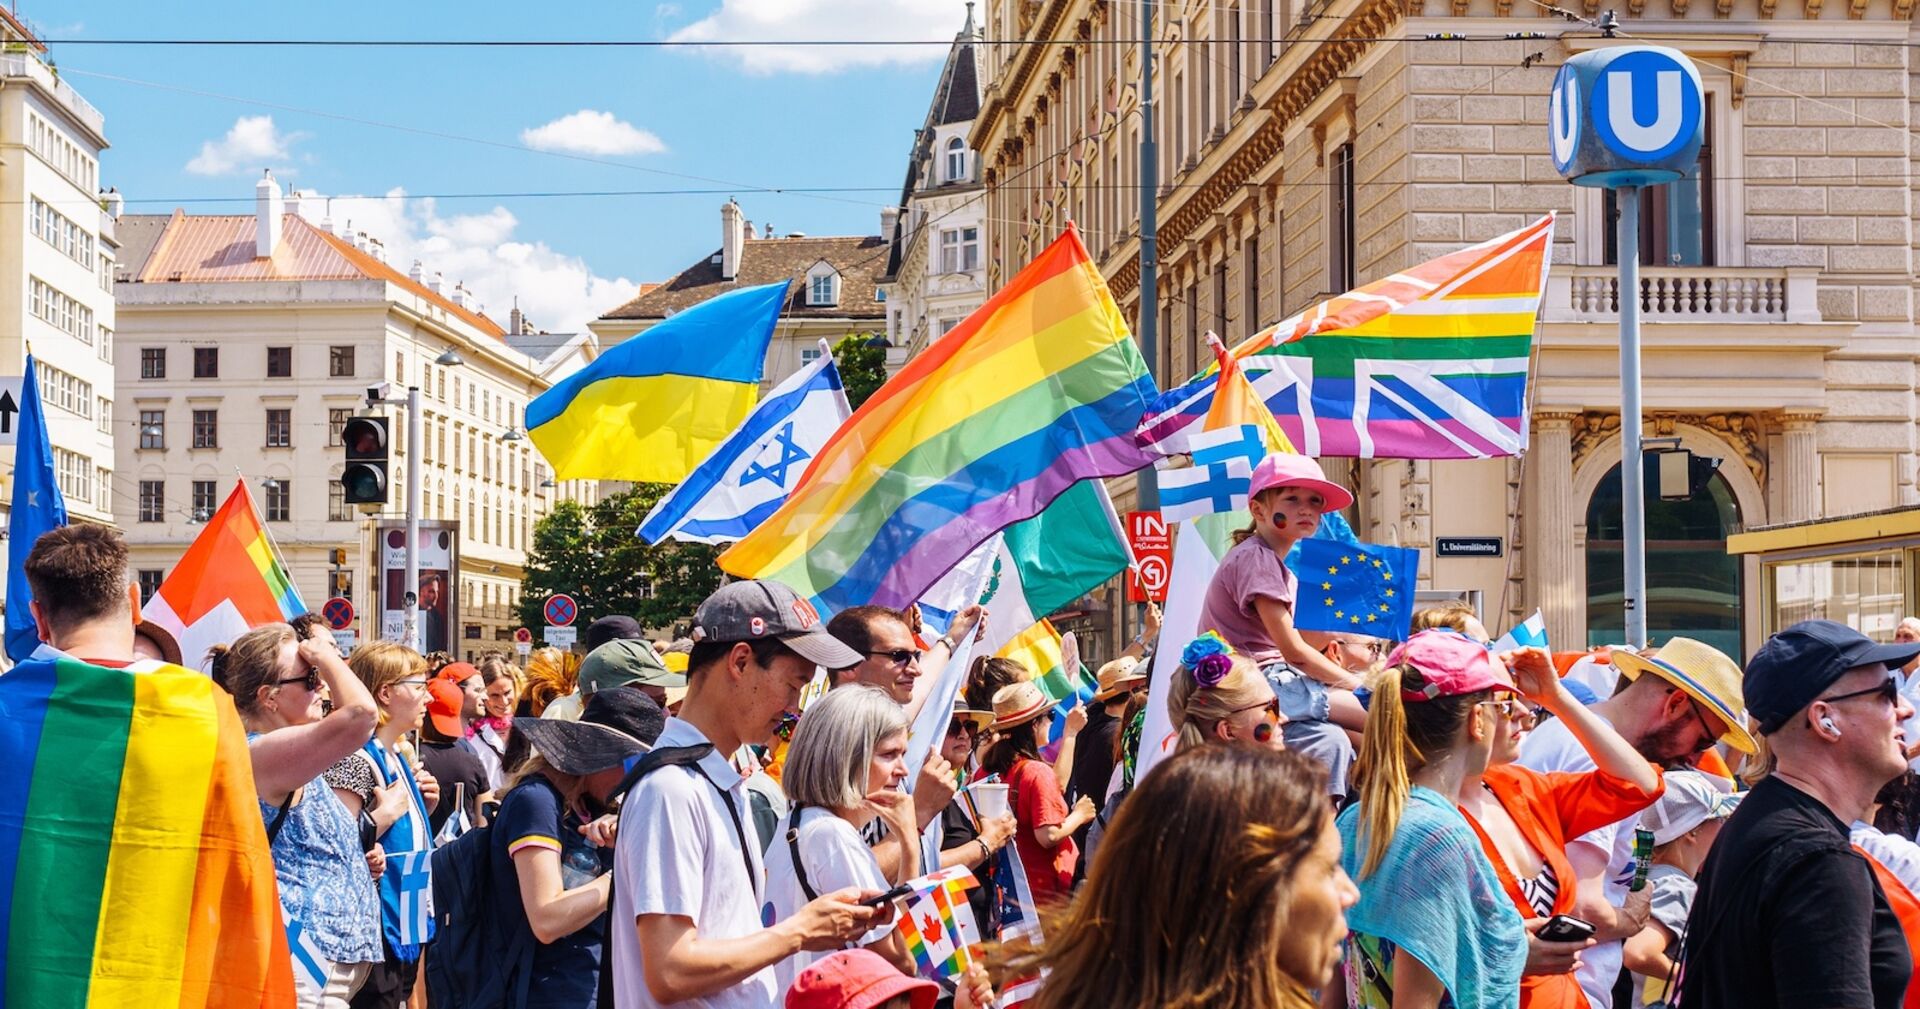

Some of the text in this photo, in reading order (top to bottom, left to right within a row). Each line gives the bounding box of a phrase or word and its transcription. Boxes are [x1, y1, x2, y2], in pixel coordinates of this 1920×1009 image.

[1553, 78, 1577, 164] U
[1608, 71, 1682, 152] U
[1136, 516, 1167, 536] IN
[1442, 543, 1449, 551] 1.
